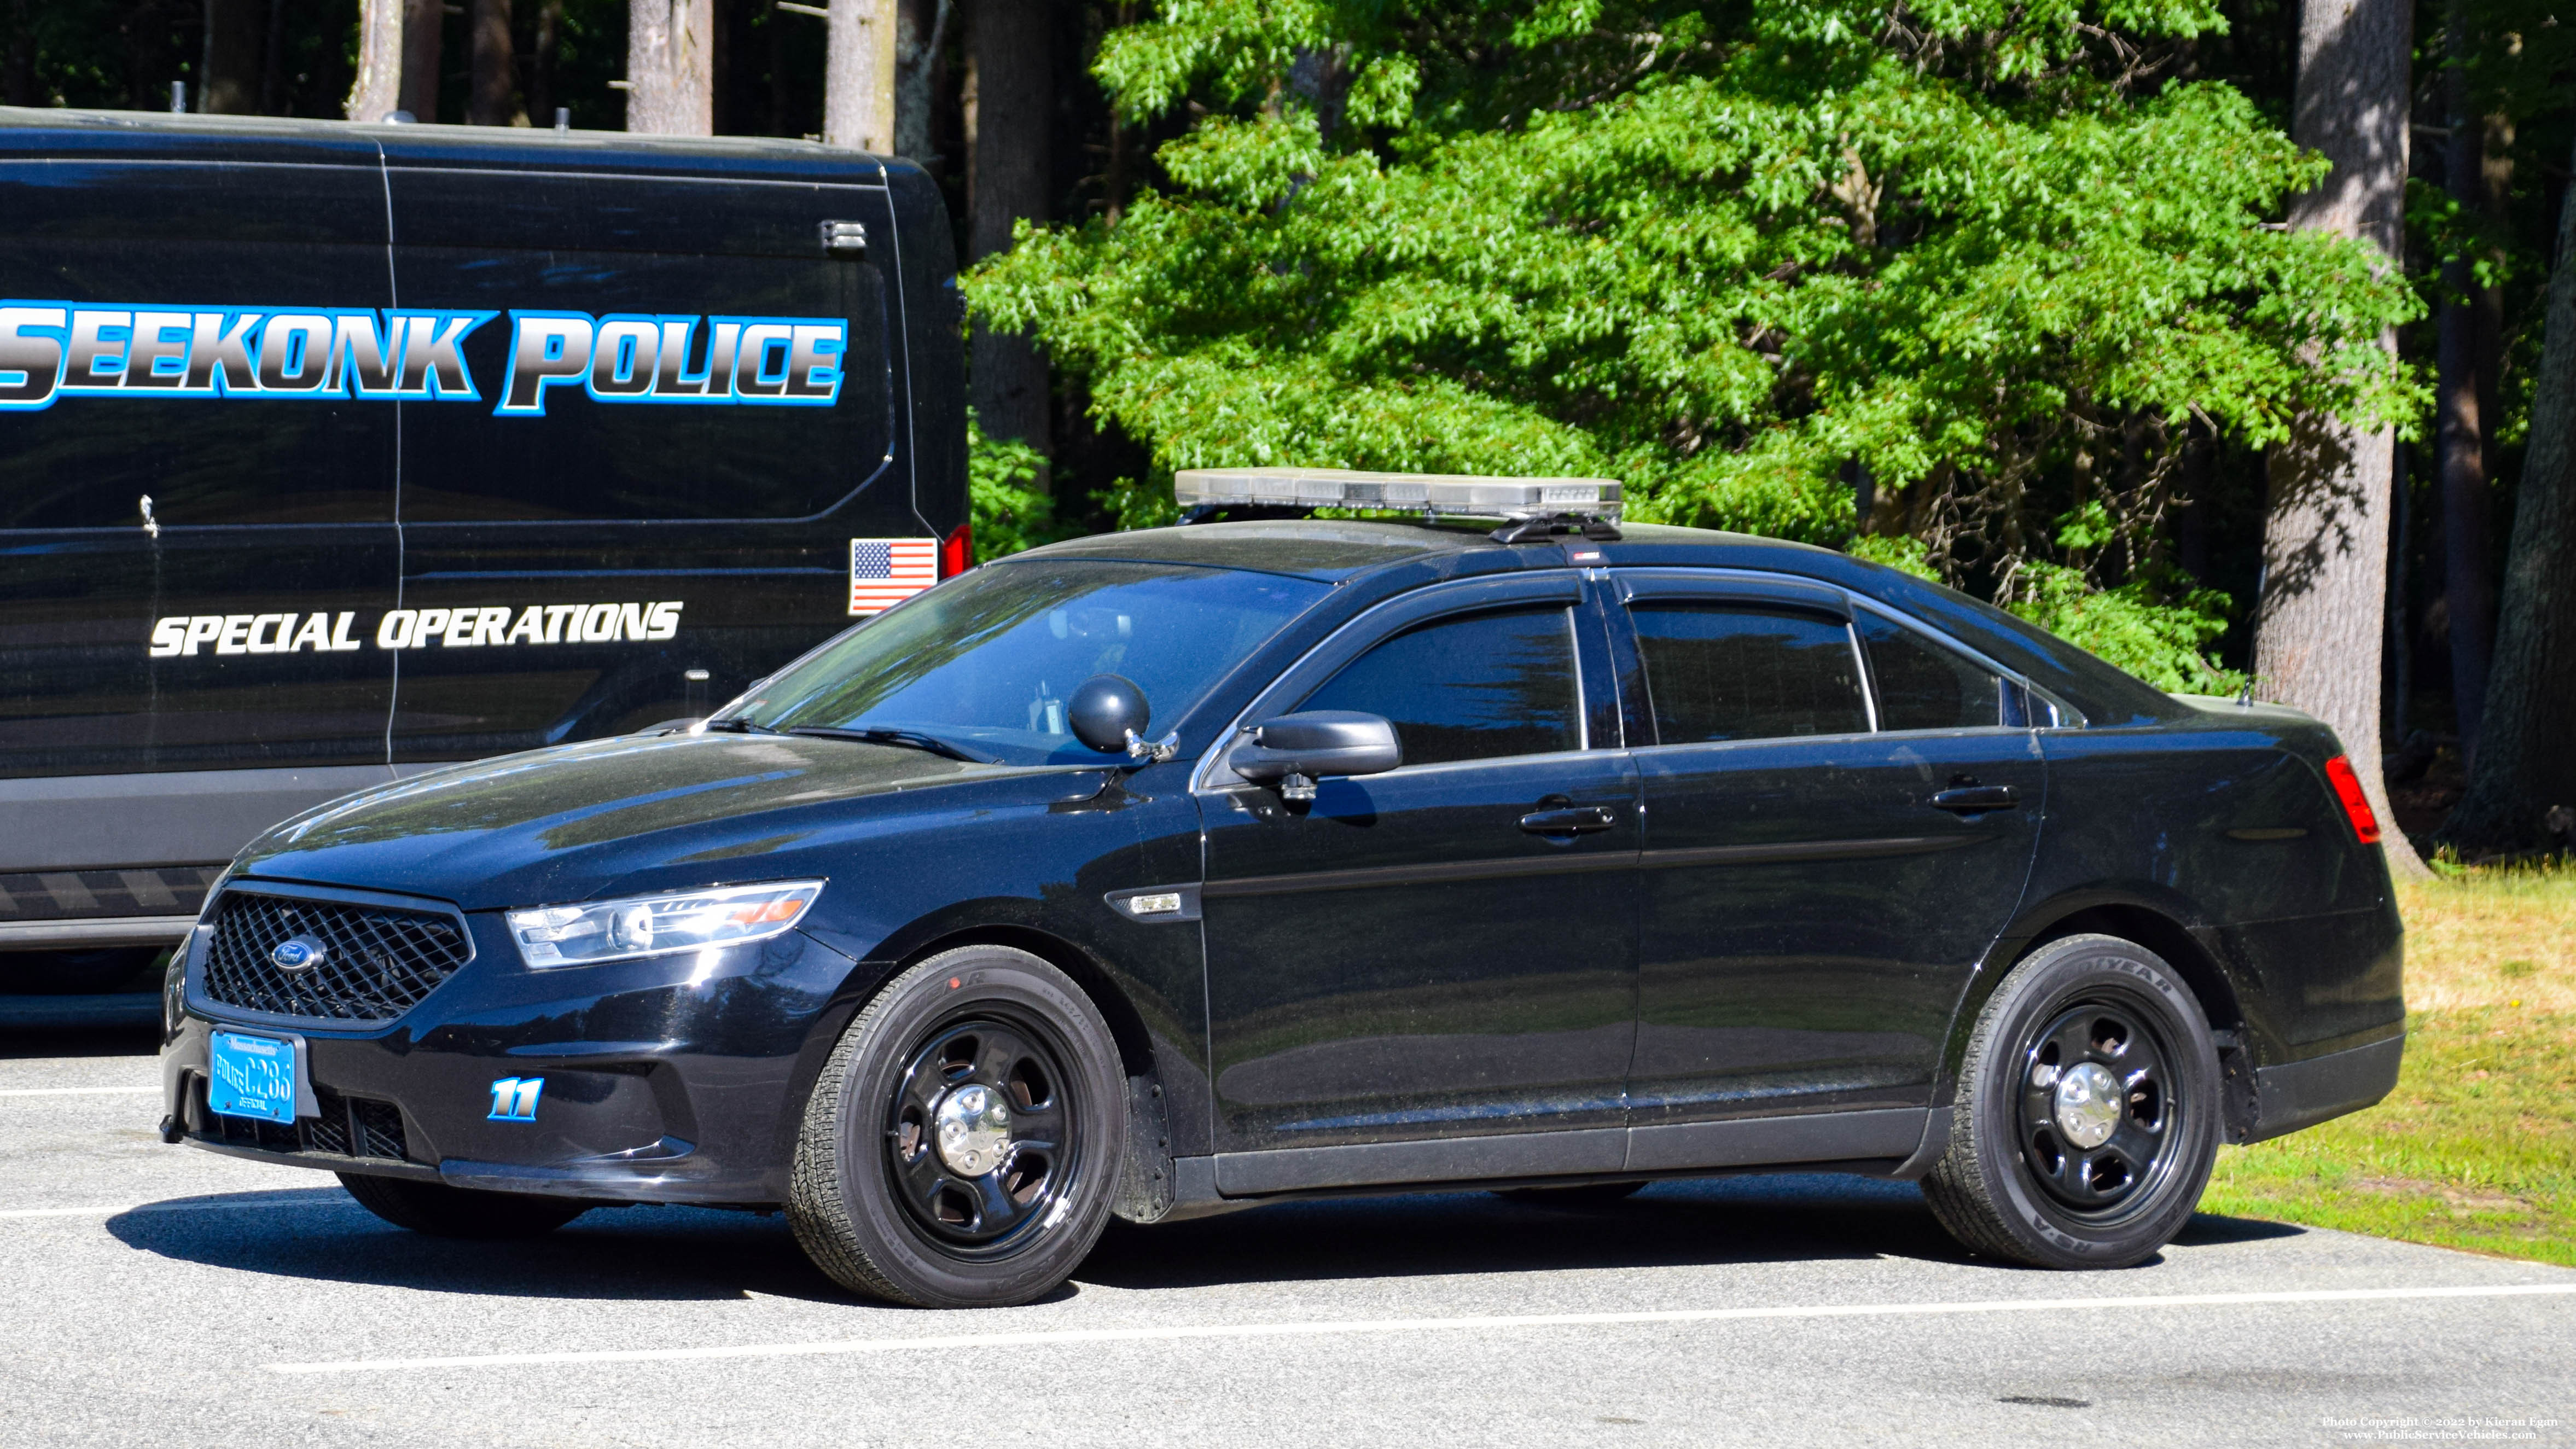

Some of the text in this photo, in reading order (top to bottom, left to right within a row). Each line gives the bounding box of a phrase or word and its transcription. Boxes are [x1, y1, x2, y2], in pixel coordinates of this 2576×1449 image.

[0, 301, 847, 416] SEEKONK POLICE
[149, 602, 683, 656] SPECIAL OPERATIONS
[278, 945, 303, 962] Ford
[229, 1037, 276, 1056] Massachusetts
[217, 1054, 245, 1095] POLICE
[239, 1096, 268, 1112] OFFICIAL
[487, 1077, 544, 1122] 11
